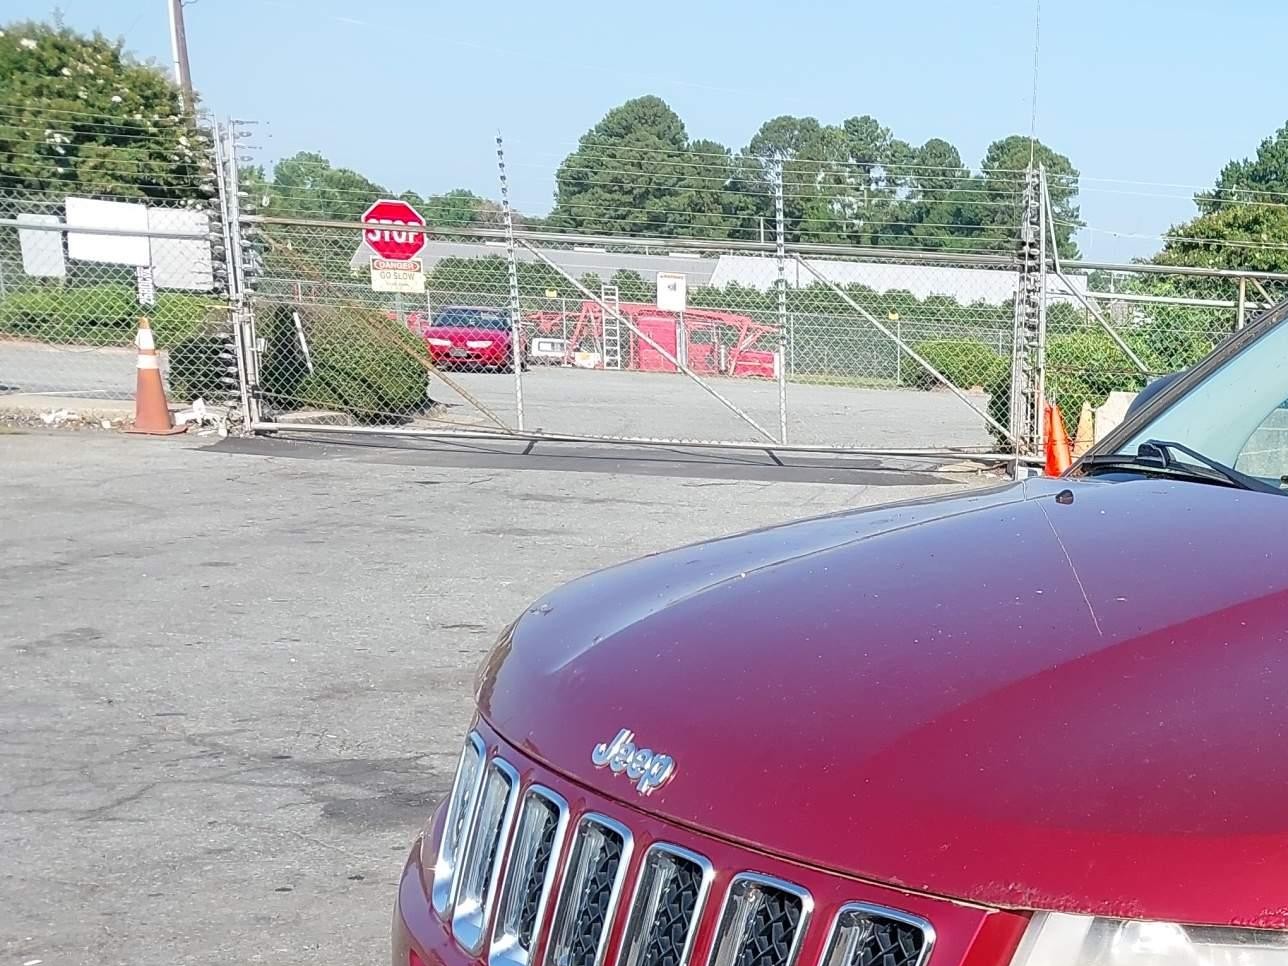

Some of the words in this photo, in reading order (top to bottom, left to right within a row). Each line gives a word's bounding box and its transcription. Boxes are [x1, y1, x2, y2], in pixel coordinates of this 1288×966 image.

[367, 219, 421, 243] STOP
[380, 271, 392, 280] GO
[393, 271, 415, 280] SLOW
[591, 728, 674, 794] Jeep
